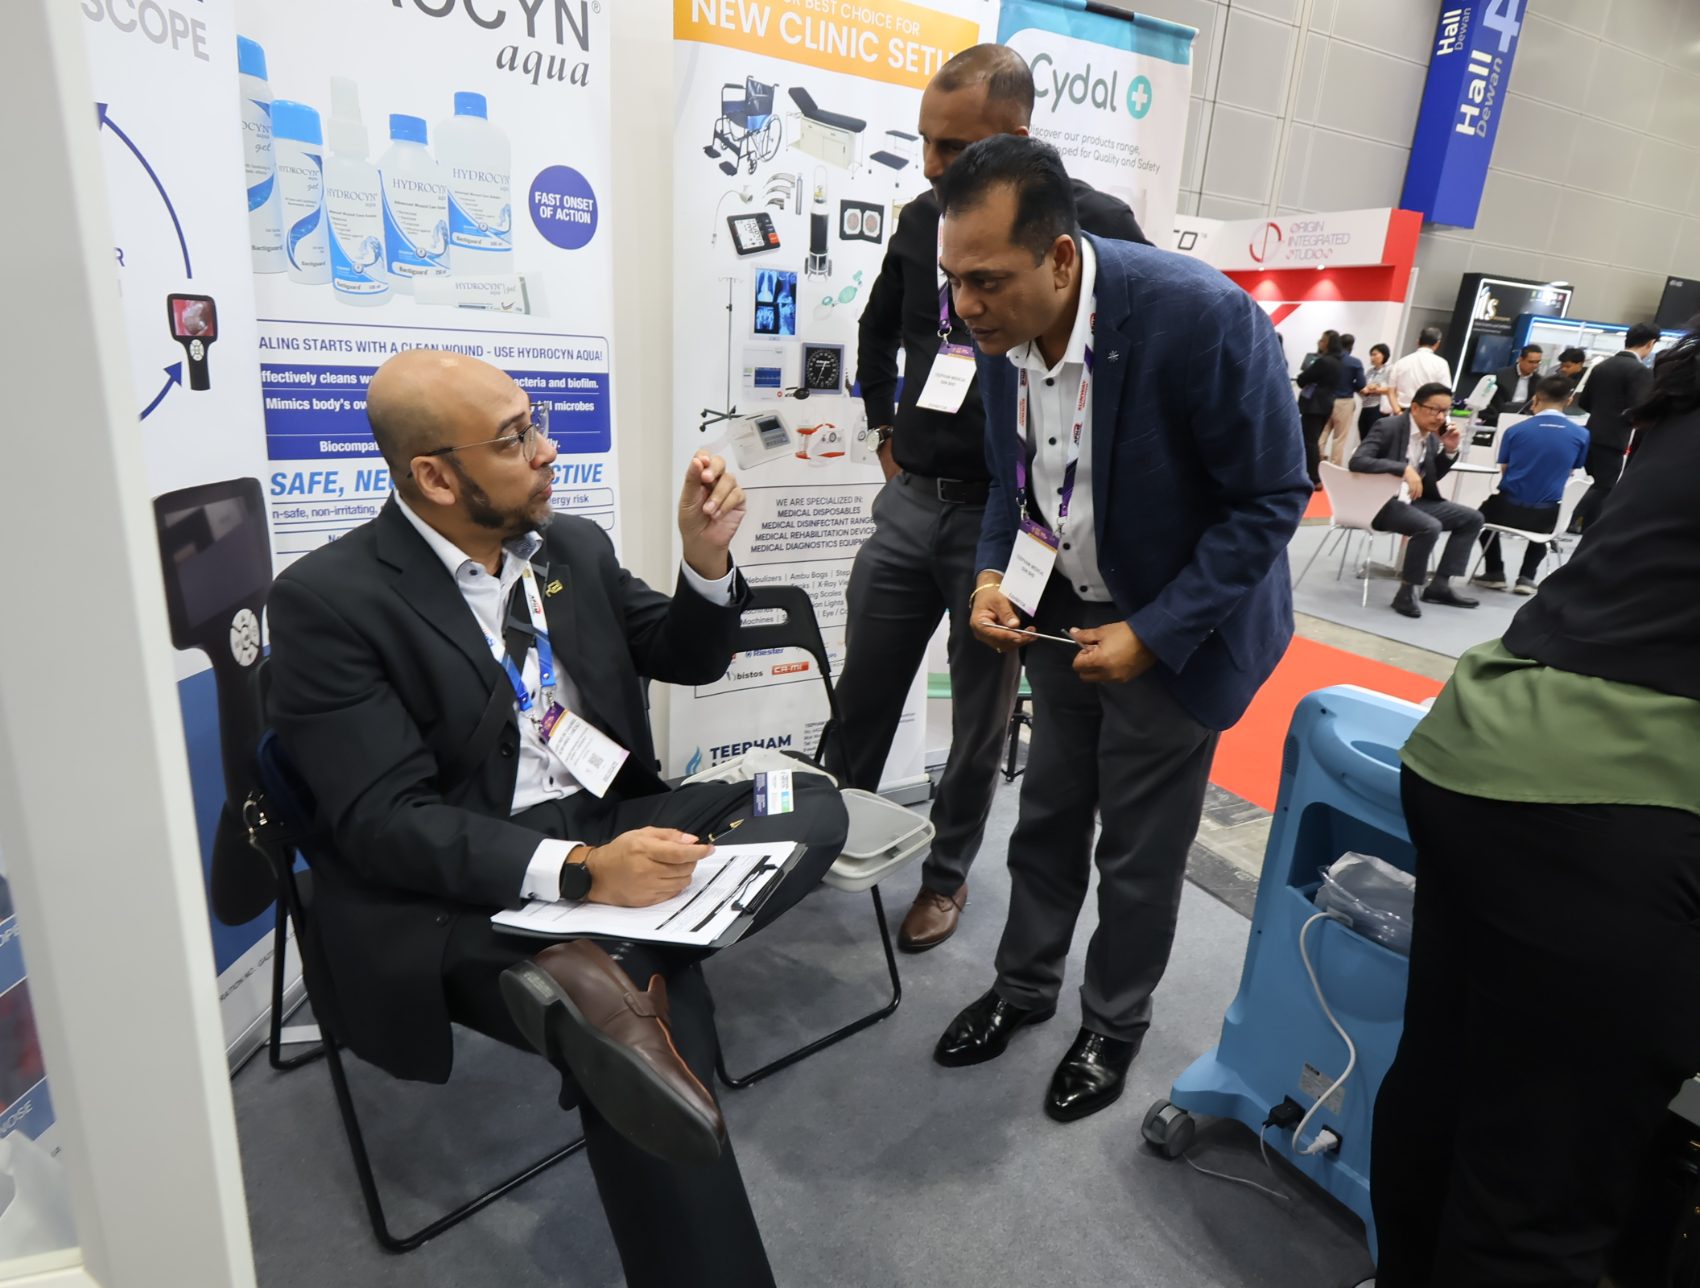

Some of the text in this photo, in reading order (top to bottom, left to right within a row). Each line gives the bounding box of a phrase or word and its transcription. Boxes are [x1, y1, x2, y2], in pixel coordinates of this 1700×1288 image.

[840, 3, 892, 30] CHOICE
[896, 17, 921, 36] FOR
[1454, 7, 1472, 51] Dewan
[691, 0, 771, 38] NEW
[779, 11, 880, 63] CLINIC
[1436, 8, 1462, 56] Hall
[496, 44, 590, 87] aqua
[1030, 52, 1118, 113] Cydal
[1455, 49, 1493, 136] Hall
[1476, 57, 1503, 138] Dewan
[1064, 131, 1079, 142] our
[1081, 135, 1115, 150] products
[1080, 148, 1092, 158] for
[1093, 149, 1120, 167] Quality
[1121, 157, 1137, 168] and
[1137, 158, 1161, 175] Safety
[534, 191, 594, 212] FAST ONSET
[539, 205, 591, 224] OF ACTION
[258, 336, 300, 350] ALING
[303, 338, 353, 352] STARTS
[355, 340, 387, 354] WITH
[390, 342, 398, 354] A
[494, 346, 515, 358] USE
[517, 347, 574, 360] HYDROCYN
[576, 349, 603, 361] AQUA!
[320, 372, 358, 384] cleans
[548, 377, 566, 388] and
[567, 377, 599, 389] biofilm.
[265, 397, 310, 410] Mimics
[312, 398, 351, 412] body's
[554, 400, 595, 411] microbes
[270, 469, 394, 497] SAFE, NE
[776, 498, 788, 507] WE
[789, 497, 805, 506] ARE
[806, 496, 853, 506] SPECIALIZED
[777, 506, 861, 518] MEDICAL DISPOSABLES
[761, 520, 795, 530] MEDICAL
[797, 517, 850, 528] DISINFECTANT
[755, 532, 788, 541] MEDICAL
[790, 528, 849, 539] REHABILITATION
[750, 543, 785, 553] MEDICAL
[785, 540, 838, 551] DIAGNOSTICS
[737, 671, 764, 680] bistos
